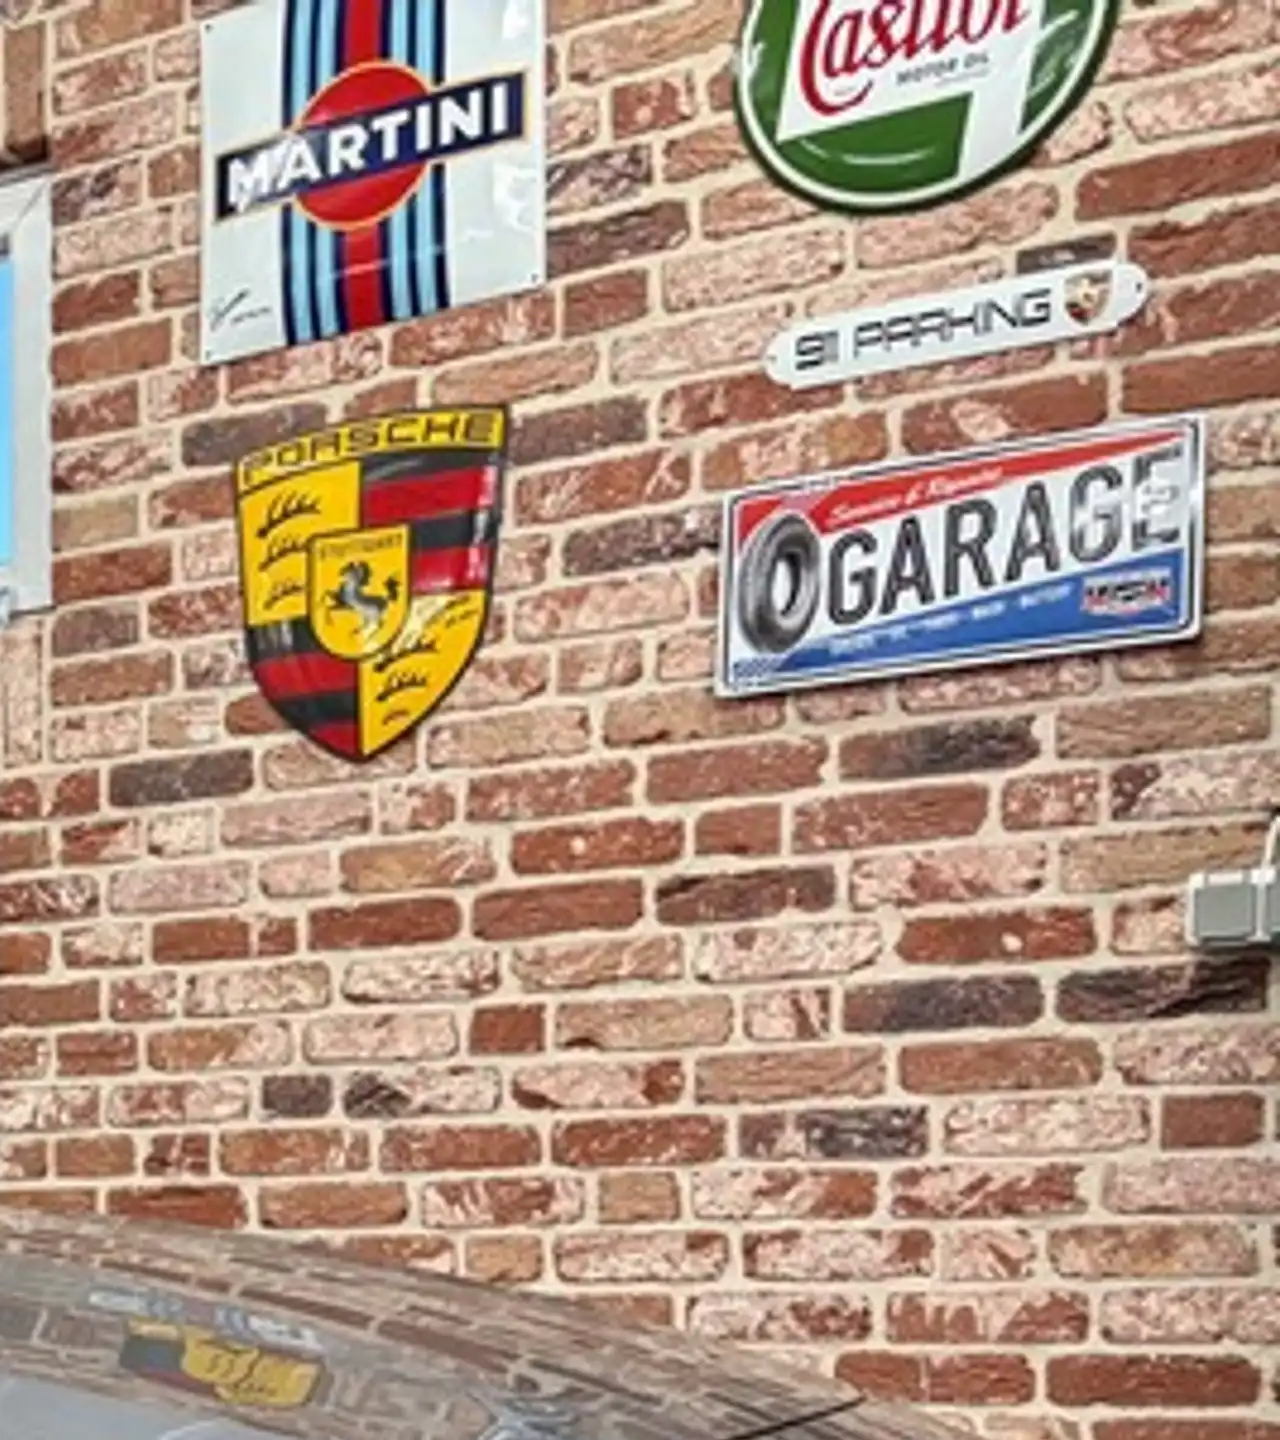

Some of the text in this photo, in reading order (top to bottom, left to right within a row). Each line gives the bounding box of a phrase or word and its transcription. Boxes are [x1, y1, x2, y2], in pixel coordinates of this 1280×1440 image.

[799, 0, 1029, 116] Castro
[227, 81, 509, 207] MARTINI
[243, 410, 494, 486] PORSCHE
[826, 446, 1183, 626] GARAGE
